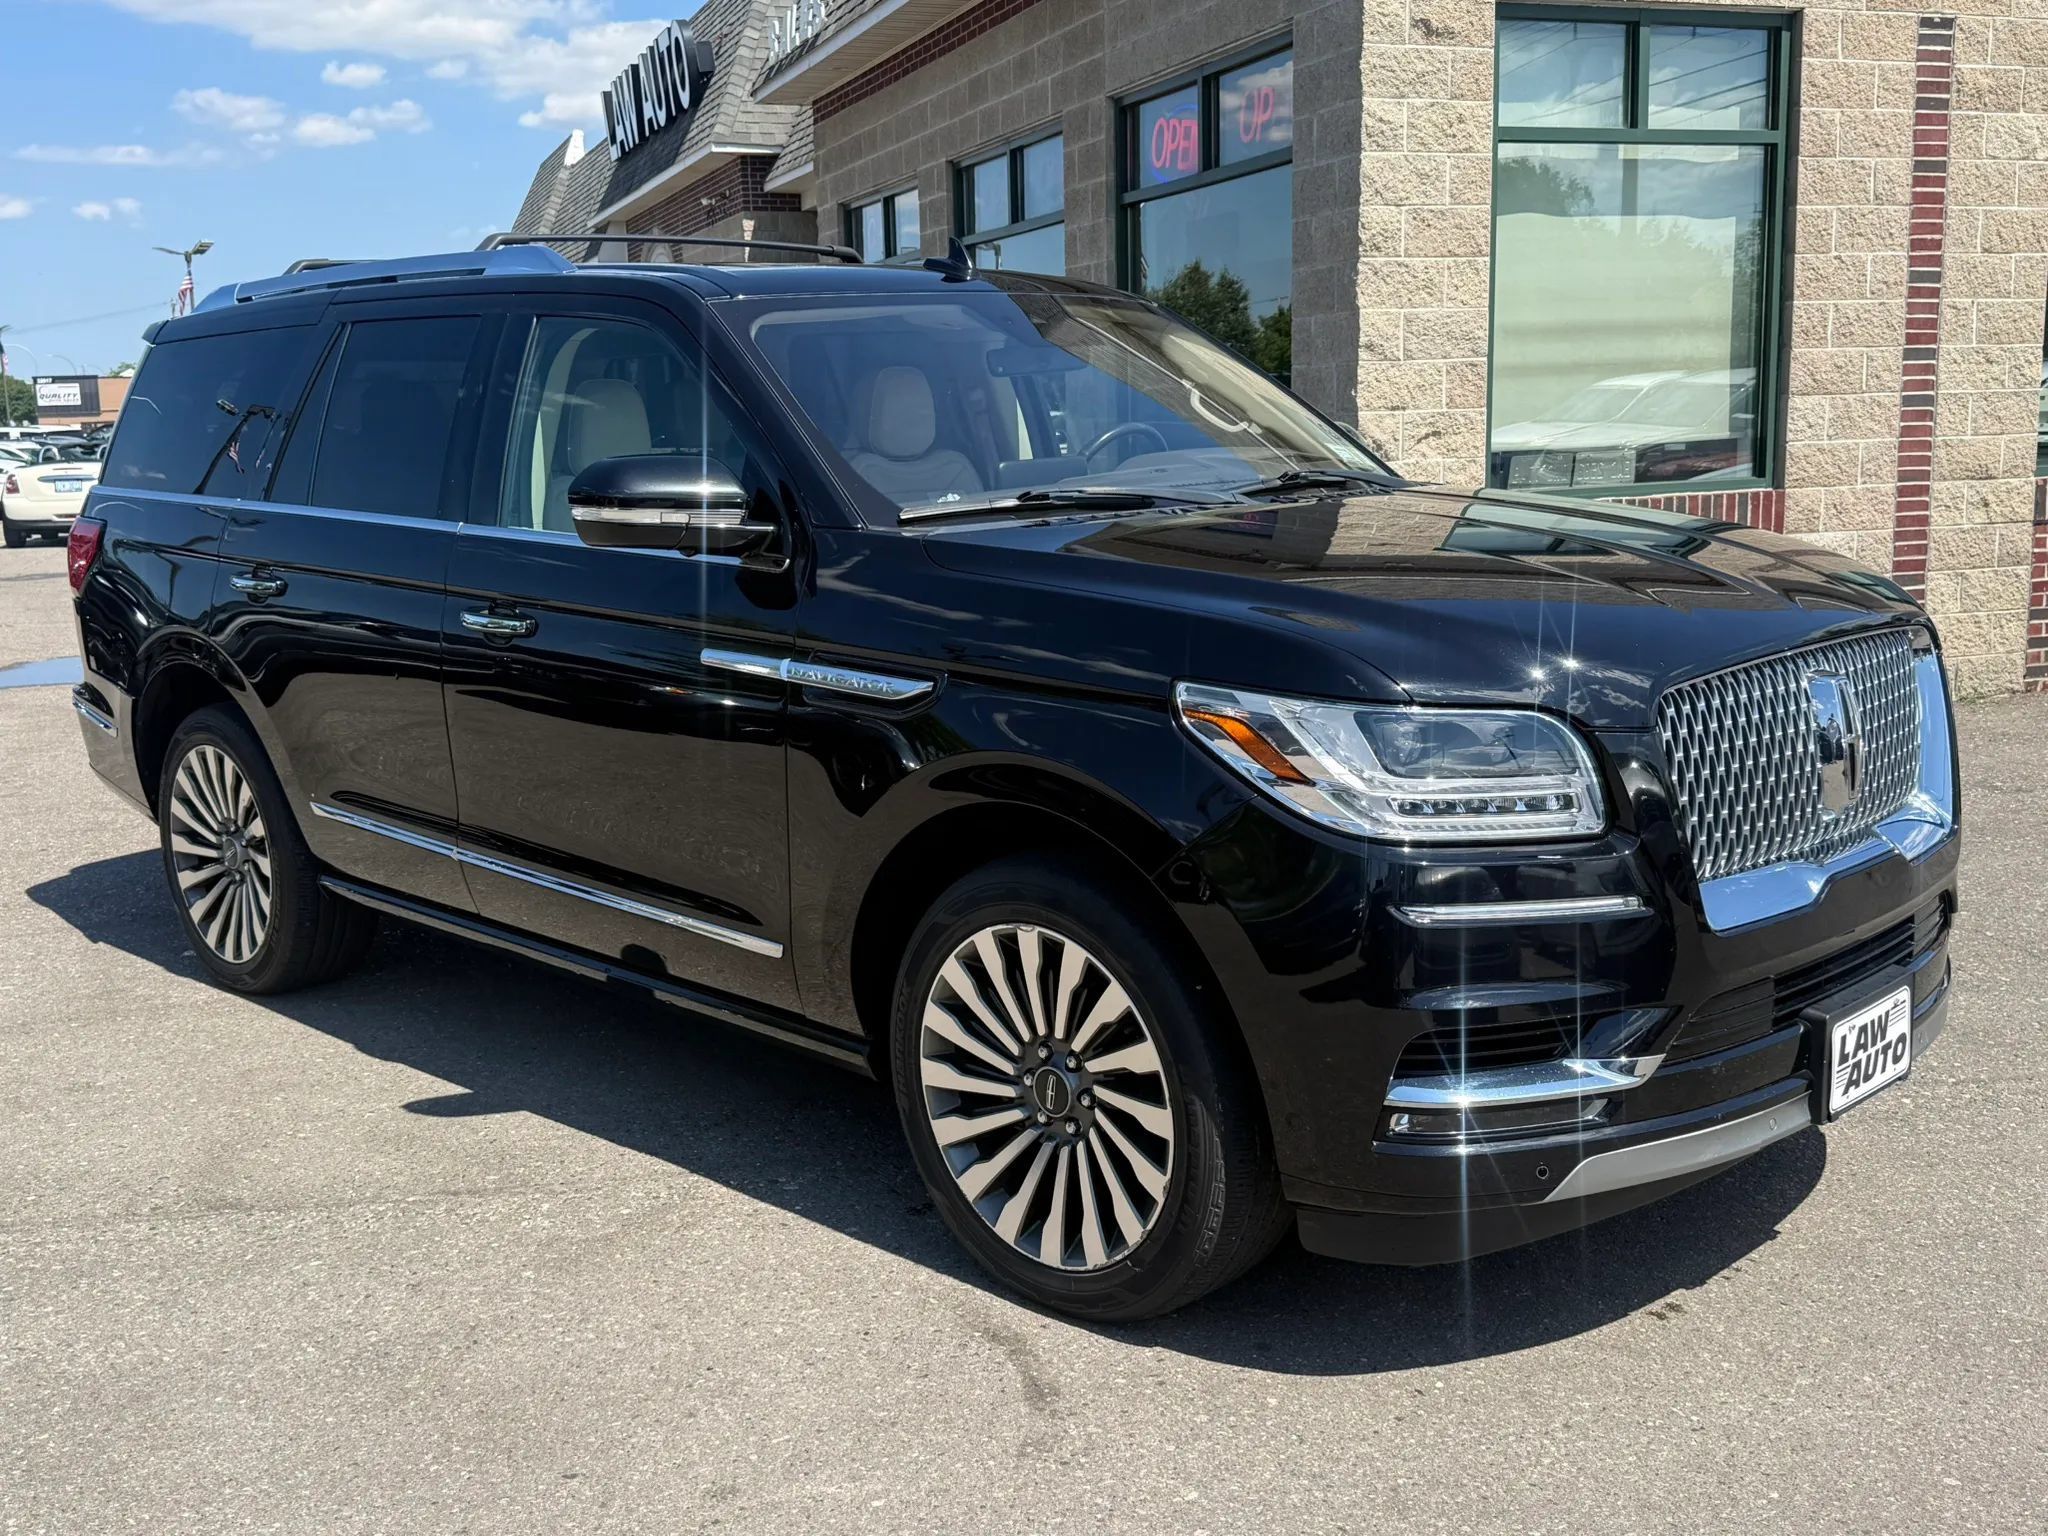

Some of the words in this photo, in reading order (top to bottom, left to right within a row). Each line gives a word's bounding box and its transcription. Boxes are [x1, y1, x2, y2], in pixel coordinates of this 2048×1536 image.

[601, 64, 639, 162] LAW
[638, 19, 692, 137] AUTO
[1239, 86, 1275, 143] UP
[1152, 116, 1198, 171] OPEN
[791, 666, 895, 694] NAVIGATOR
[1837, 1009, 1890, 1068] LAW
[1841, 1032, 1907, 1096] AUTO
